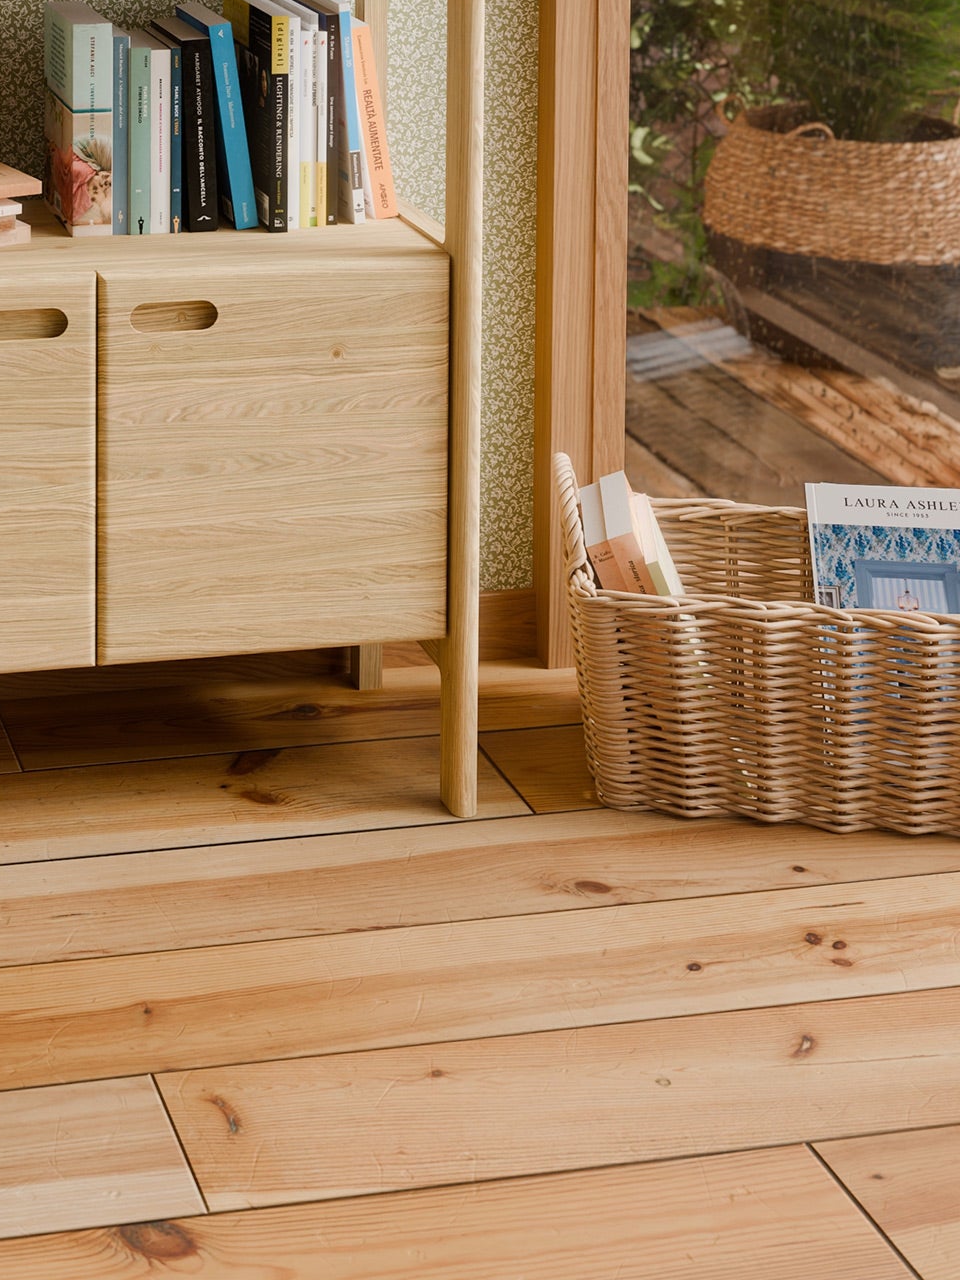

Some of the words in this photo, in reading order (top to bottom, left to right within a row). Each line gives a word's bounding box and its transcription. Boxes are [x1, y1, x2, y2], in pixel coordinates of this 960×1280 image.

[363, 89, 377, 120] REALTÀ
[368, 121, 384, 171] AUMENTATE
[844, 497, 899, 509] LAURA
[906, 500, 960, 511] ASHLE
